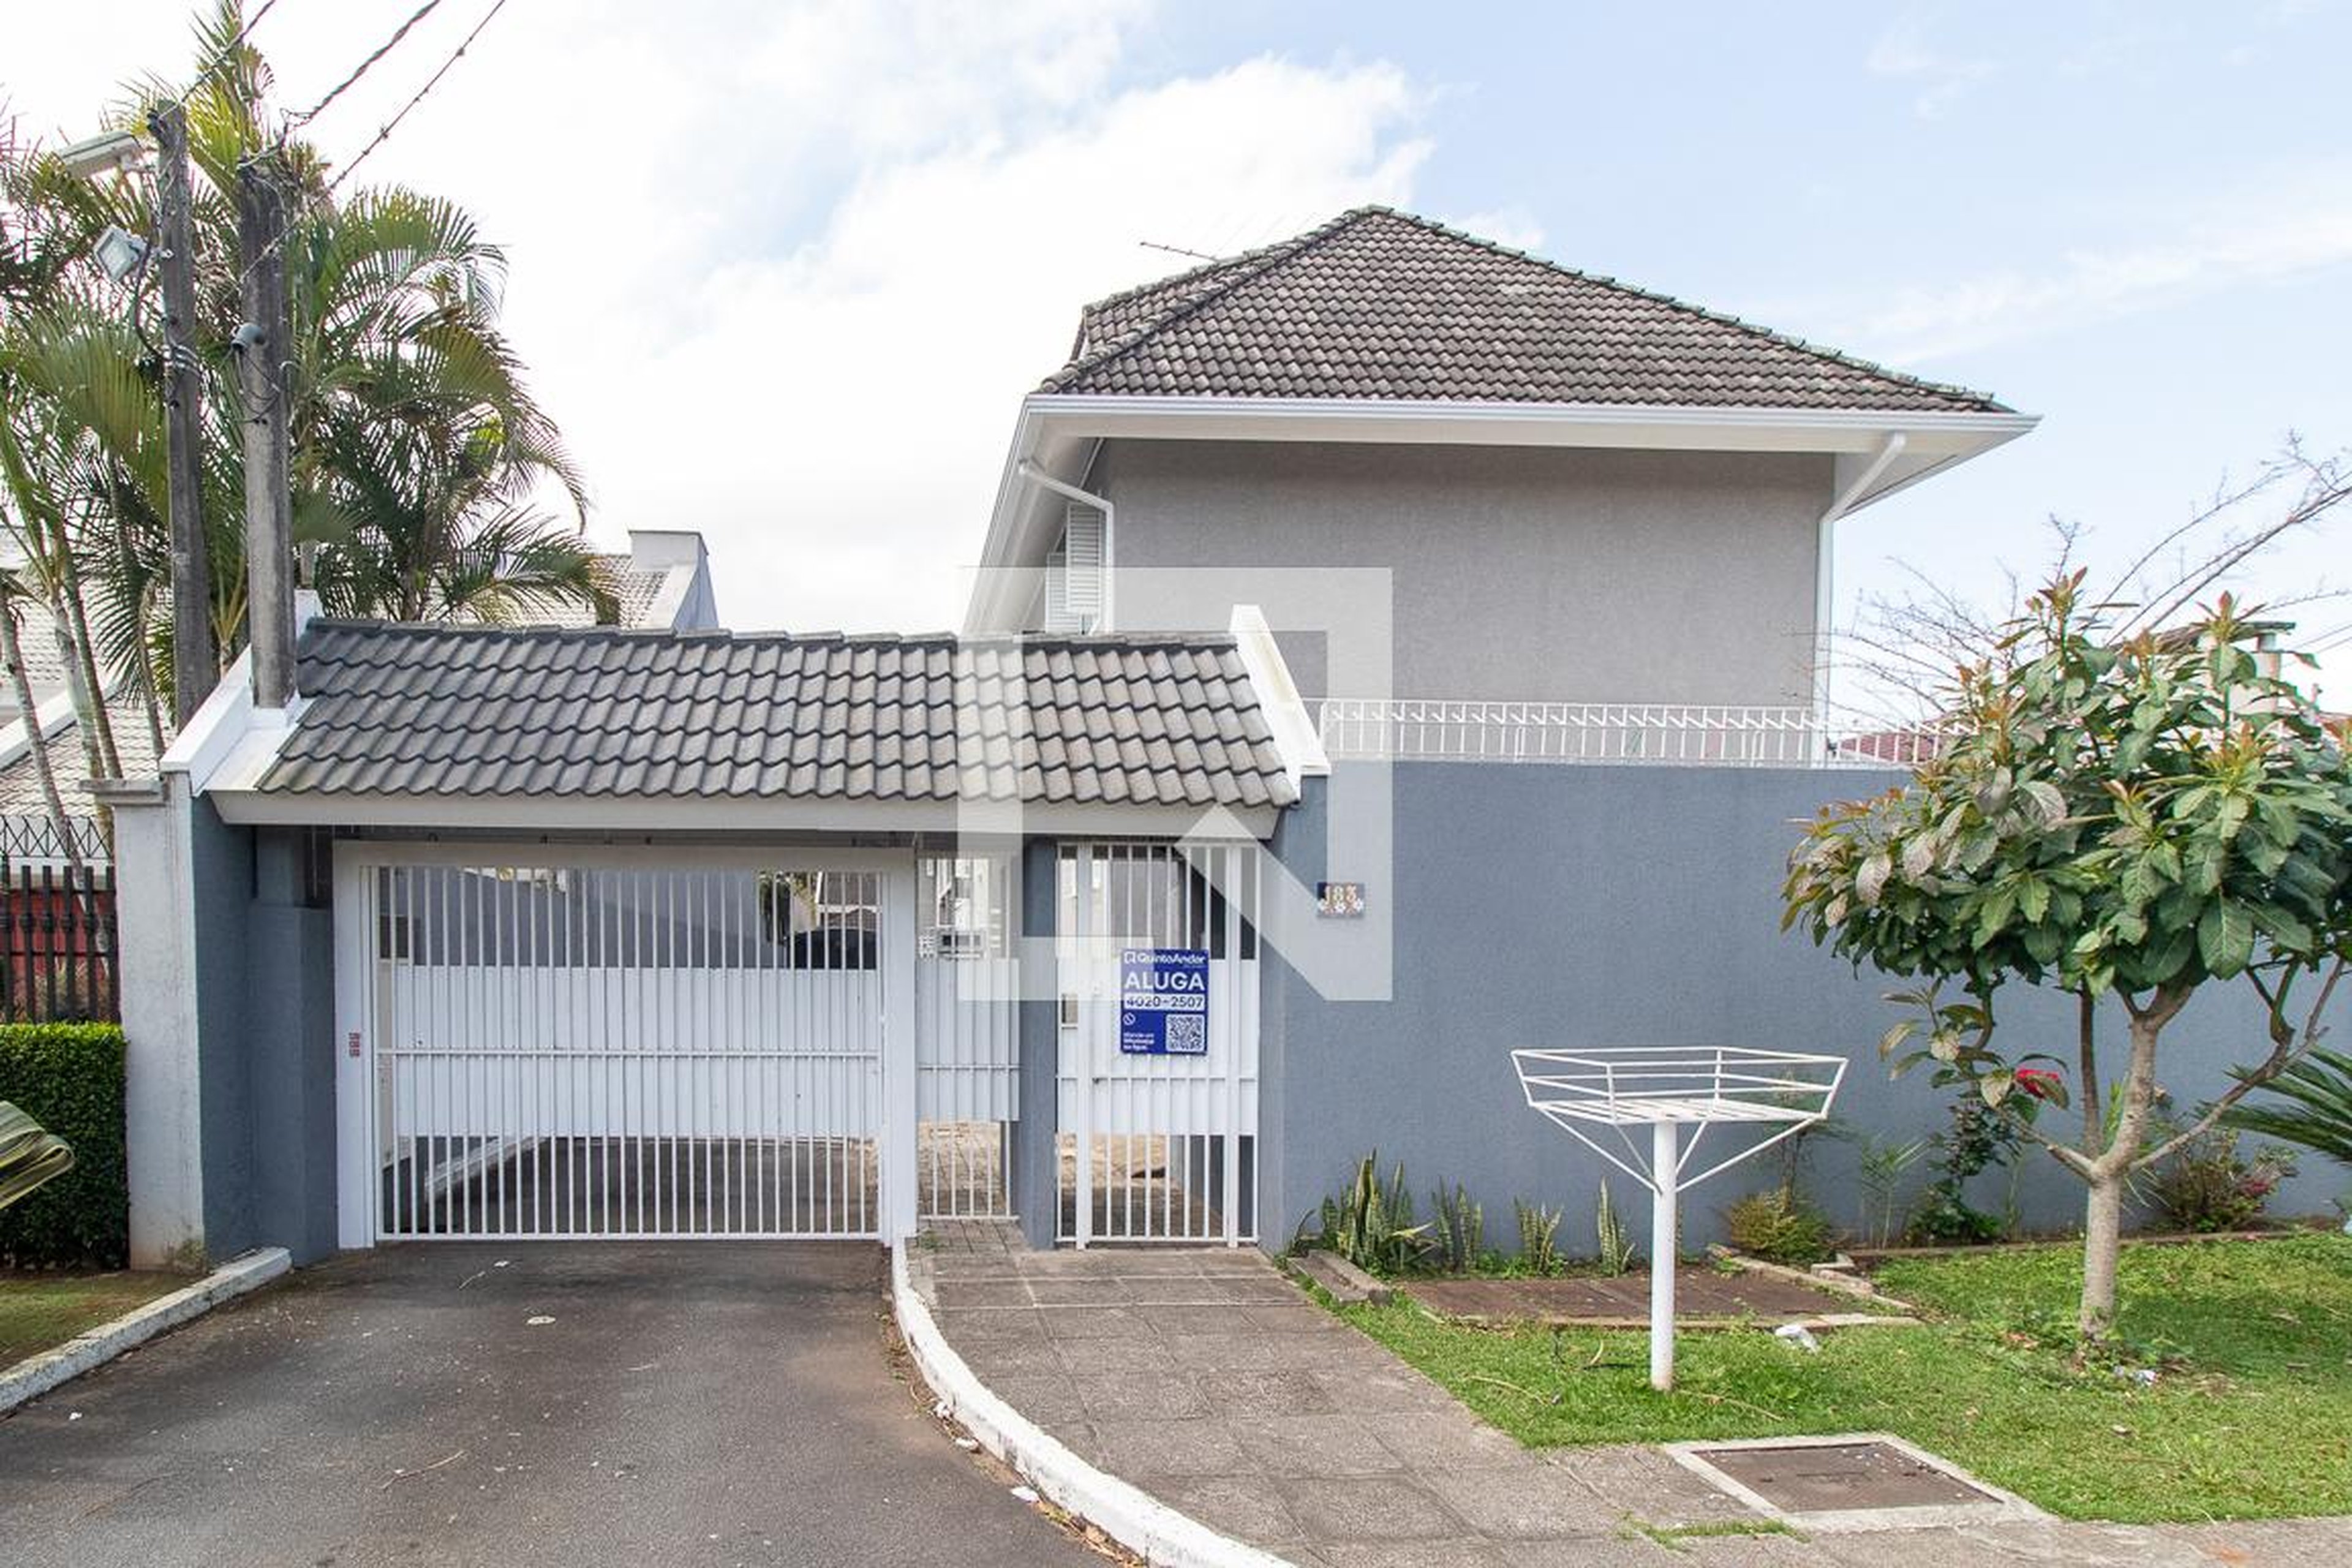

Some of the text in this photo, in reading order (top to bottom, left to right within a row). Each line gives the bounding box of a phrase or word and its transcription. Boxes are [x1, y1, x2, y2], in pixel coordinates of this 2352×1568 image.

[1137, 952, 1207, 964] QuintoAndar
[1125, 971, 1205, 991] ALUGA
[1126, 995, 1204, 1008] 4020-2507
